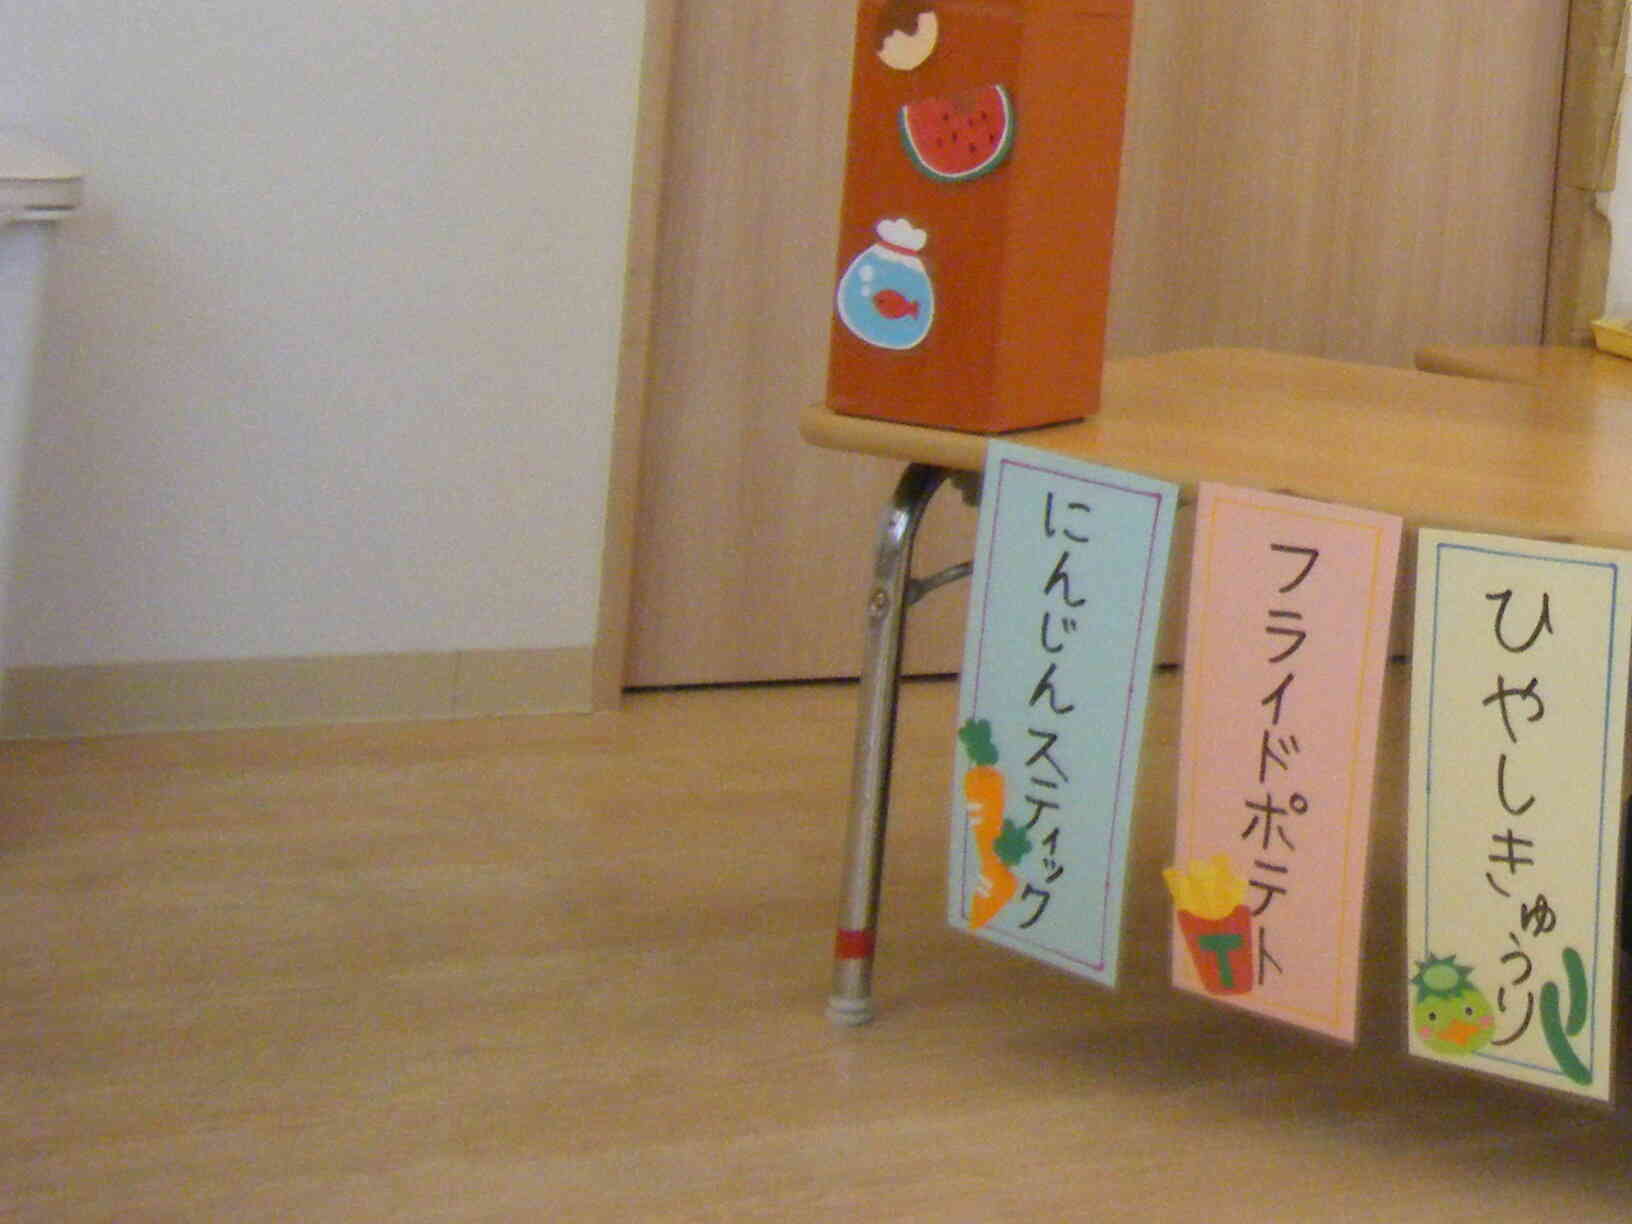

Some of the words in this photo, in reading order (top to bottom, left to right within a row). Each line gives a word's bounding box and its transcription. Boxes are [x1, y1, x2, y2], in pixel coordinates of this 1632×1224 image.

[1018, 489, 1092, 930] にんじんスティック
[1238, 541, 1320, 987] フライドポテト
[1481, 587, 1556, 1047] ひやしきゅうり
